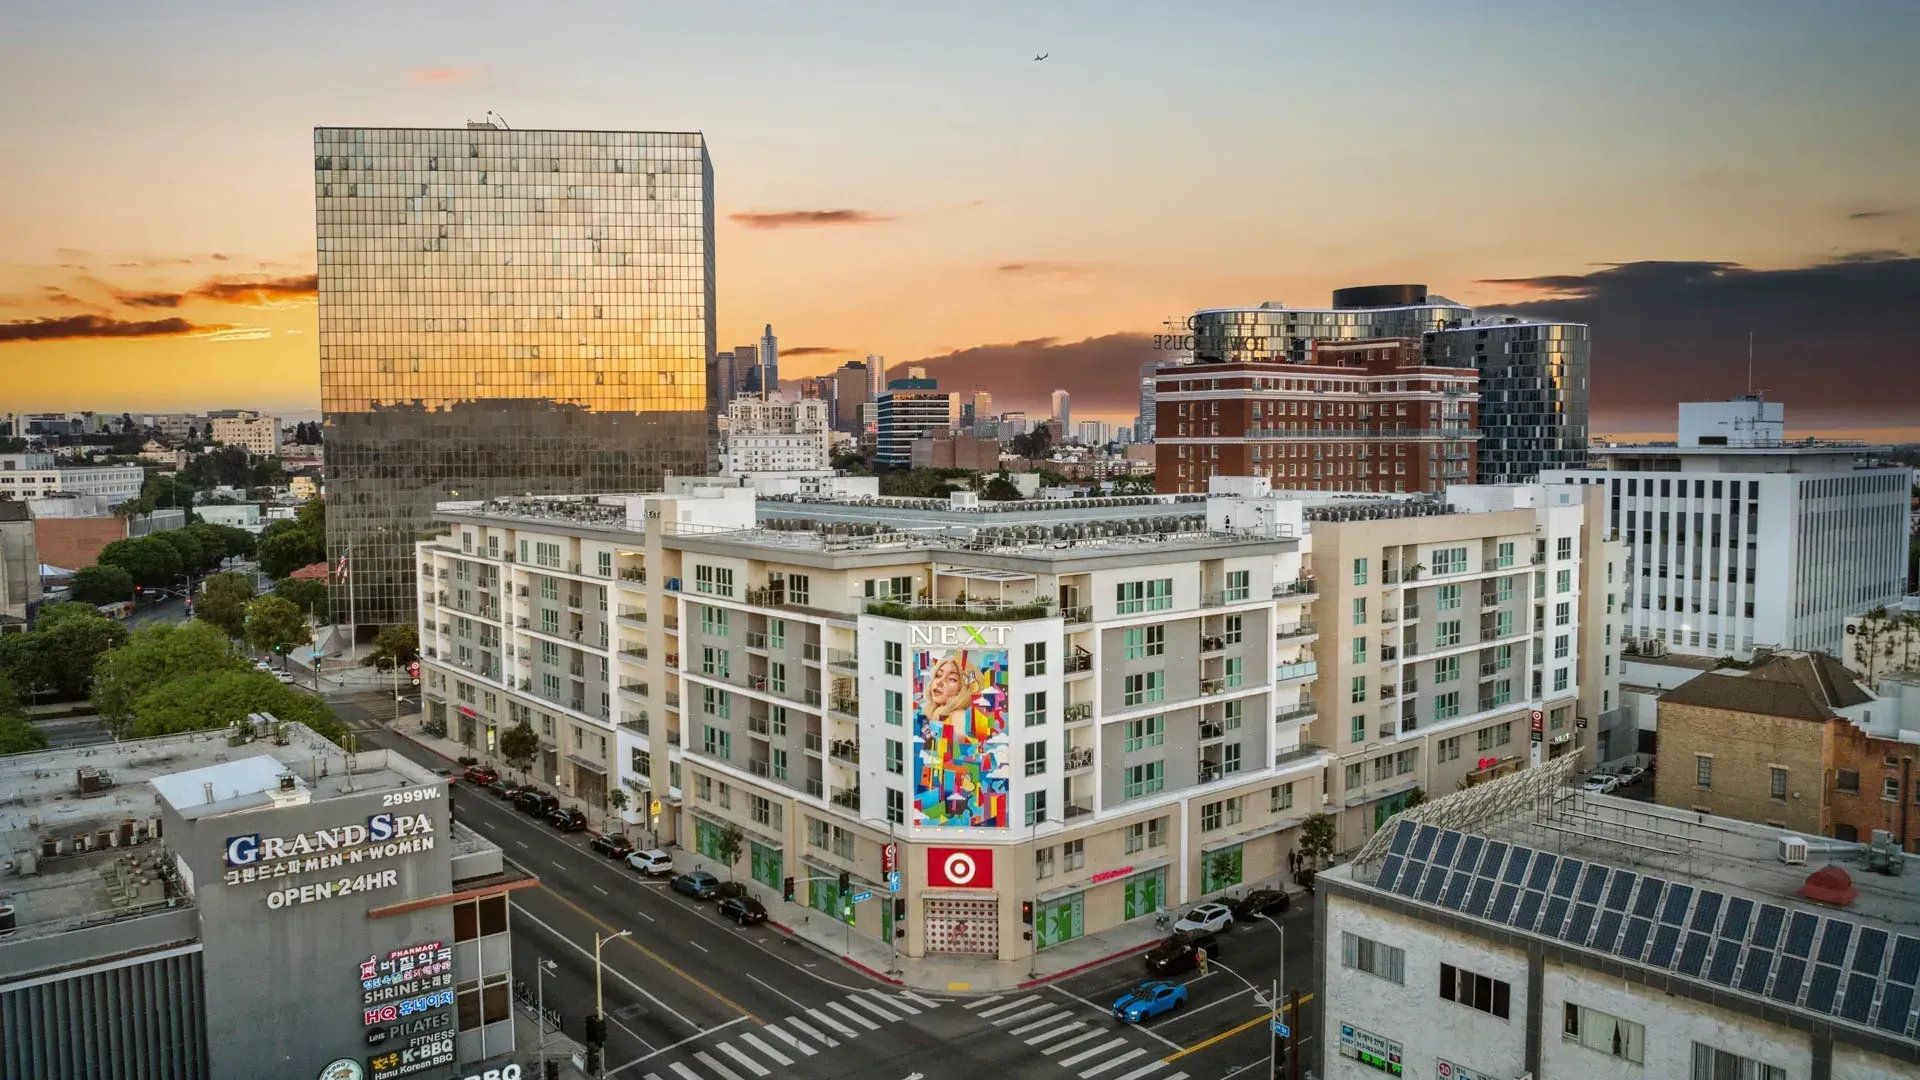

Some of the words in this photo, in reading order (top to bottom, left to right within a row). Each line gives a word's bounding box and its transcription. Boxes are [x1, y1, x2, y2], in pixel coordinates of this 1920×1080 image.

[909, 625, 1012, 646] NEXT
[227, 860, 301, 885] 그랜드스파
[305, 852, 343, 872] MEN
[350, 849, 363, 864] N
[369, 837, 434, 860] WOMEN
[267, 881, 332, 909] OPEN
[338, 869, 398, 896] 24HR
[391, 942, 439, 959] PHARMACY
[365, 981, 419, 1004] SHRINE
[422, 973, 452, 990] 노래방
[365, 1006, 397, 1025] HQ
[400, 991, 454, 1016] 휴네이처
[390, 1013, 449, 1039] PILATES
[411, 1029, 455, 1047] FITNESS
[402, 1039, 453, 1064] K-BBQ
[375, 1070, 398, 1080] Hanu
[400, 1060, 431, 1074] Korean
[433, 1053, 453, 1065] BBQ
